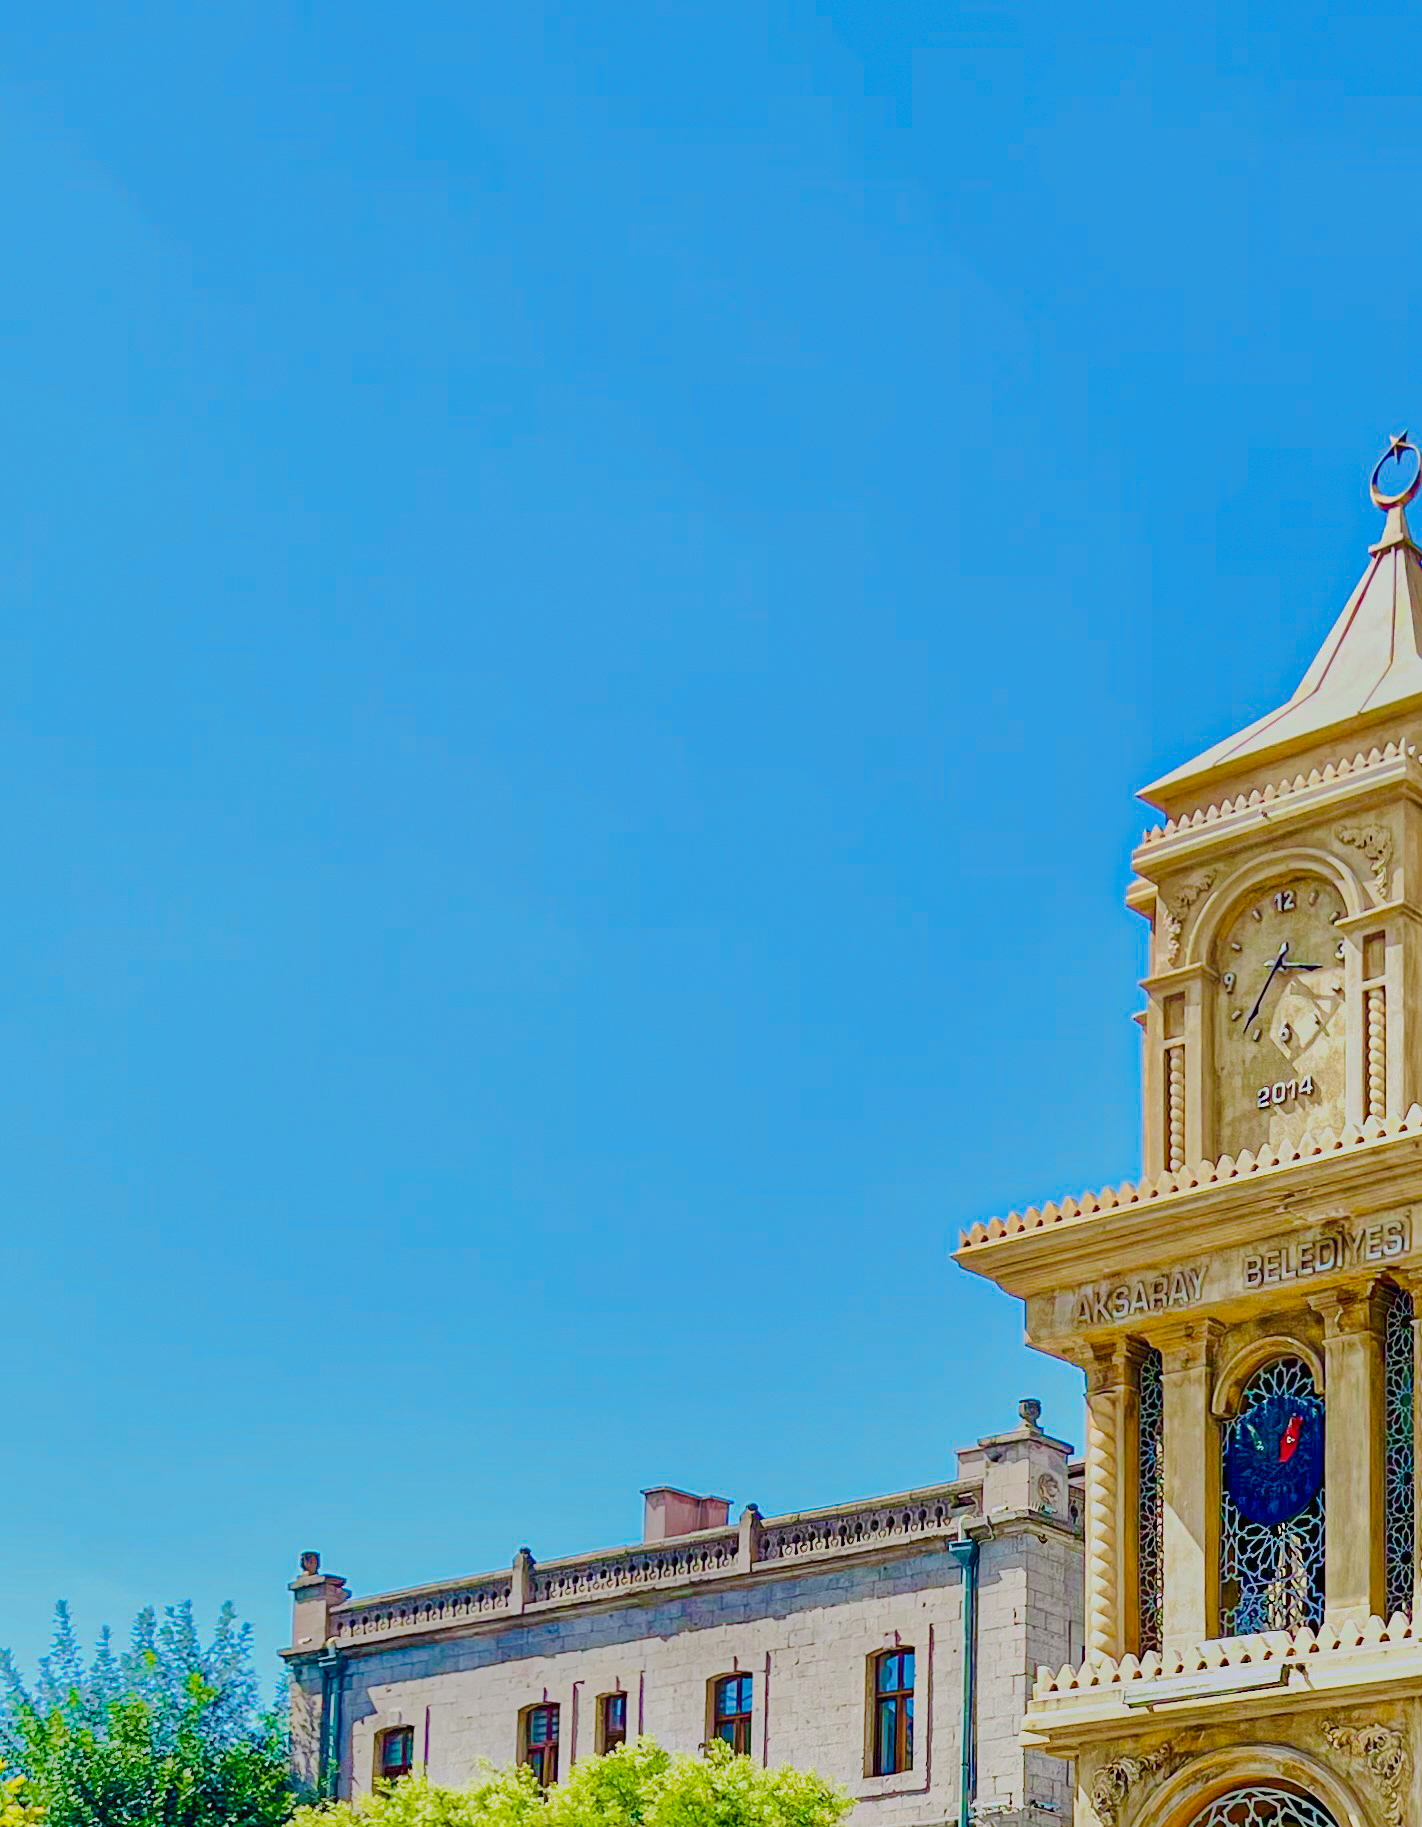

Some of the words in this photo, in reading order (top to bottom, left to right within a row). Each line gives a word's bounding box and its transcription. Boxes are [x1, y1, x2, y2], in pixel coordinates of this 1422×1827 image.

[1274, 890, 1296, 912] 12
[1224, 972, 1237, 994] 9
[1257, 1075, 1314, 1109] 2014
[1073, 1265, 1208, 1325] AKSARAY
